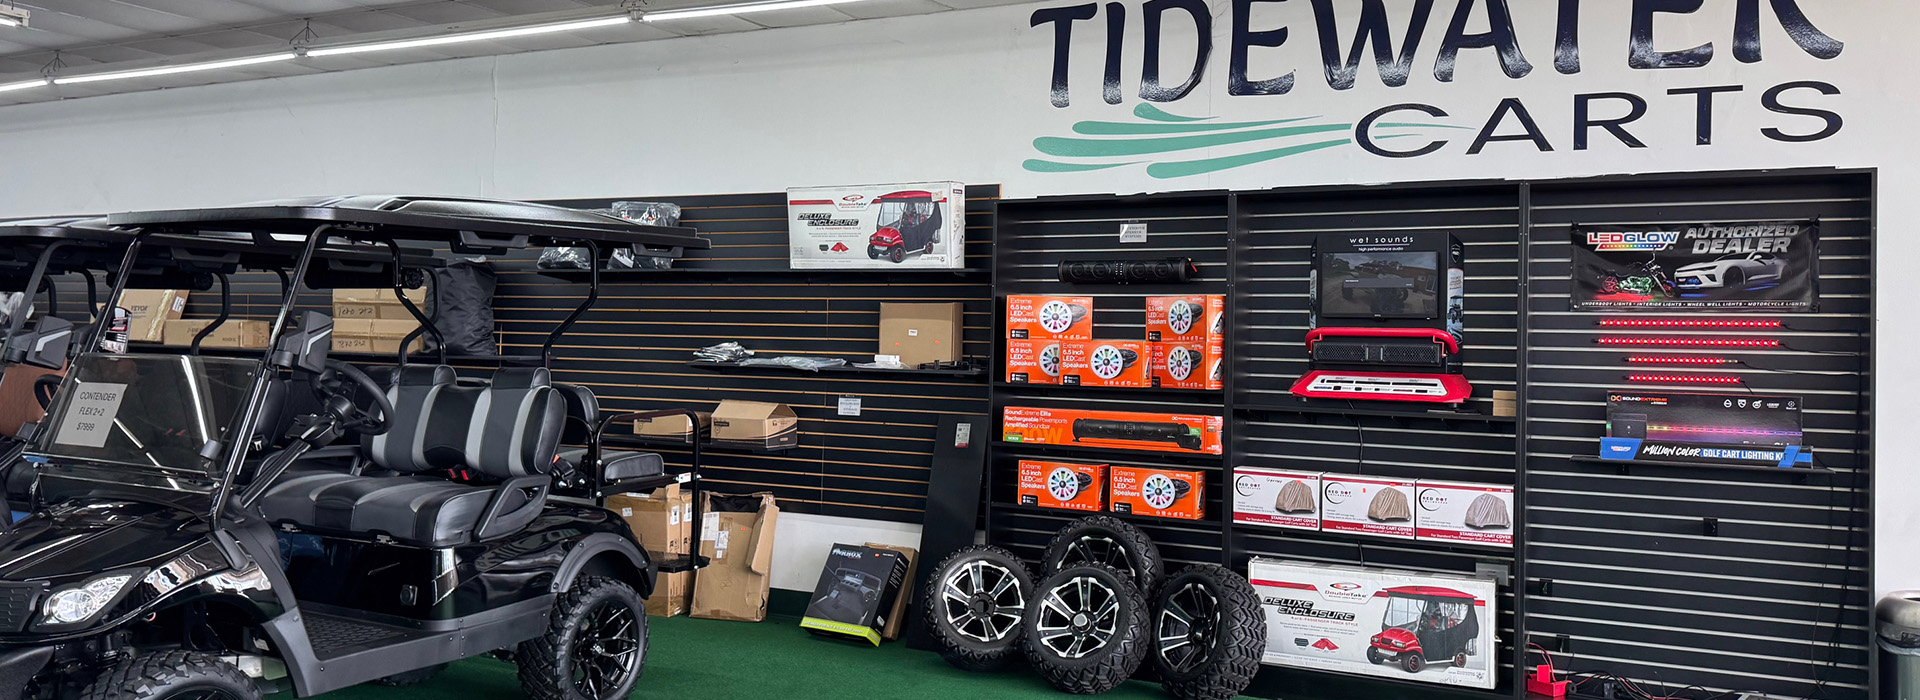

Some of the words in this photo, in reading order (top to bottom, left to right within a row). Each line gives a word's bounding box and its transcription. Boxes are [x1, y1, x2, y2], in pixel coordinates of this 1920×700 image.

[1355, 81, 1843, 158] CARTS
[1586, 230, 1681, 243] LEDGLOW
[1684, 225, 1800, 239] AUTHORIZED
[1692, 237, 1792, 254] DEALER
[80, 391, 117, 401] CONTENDER
[79, 406, 93, 415] FLEX
[93, 407, 105, 416] 2+2
[77, 422, 95, 431] $7999
[1643, 445, 1676, 456] MILLION
[1703, 449, 1720, 458] GOLF
[1721, 450, 1740, 459] CART
[1741, 451, 1774, 460] LIGHTING
[1021, 482, 1046, 490] Speakers
[1113, 489, 1140, 497] Speakers
[1325, 590, 1367, 598] DoubleTake
[1263, 596, 1314, 609] DELUXE
[1278, 606, 1355, 621] ENCLOSURE
